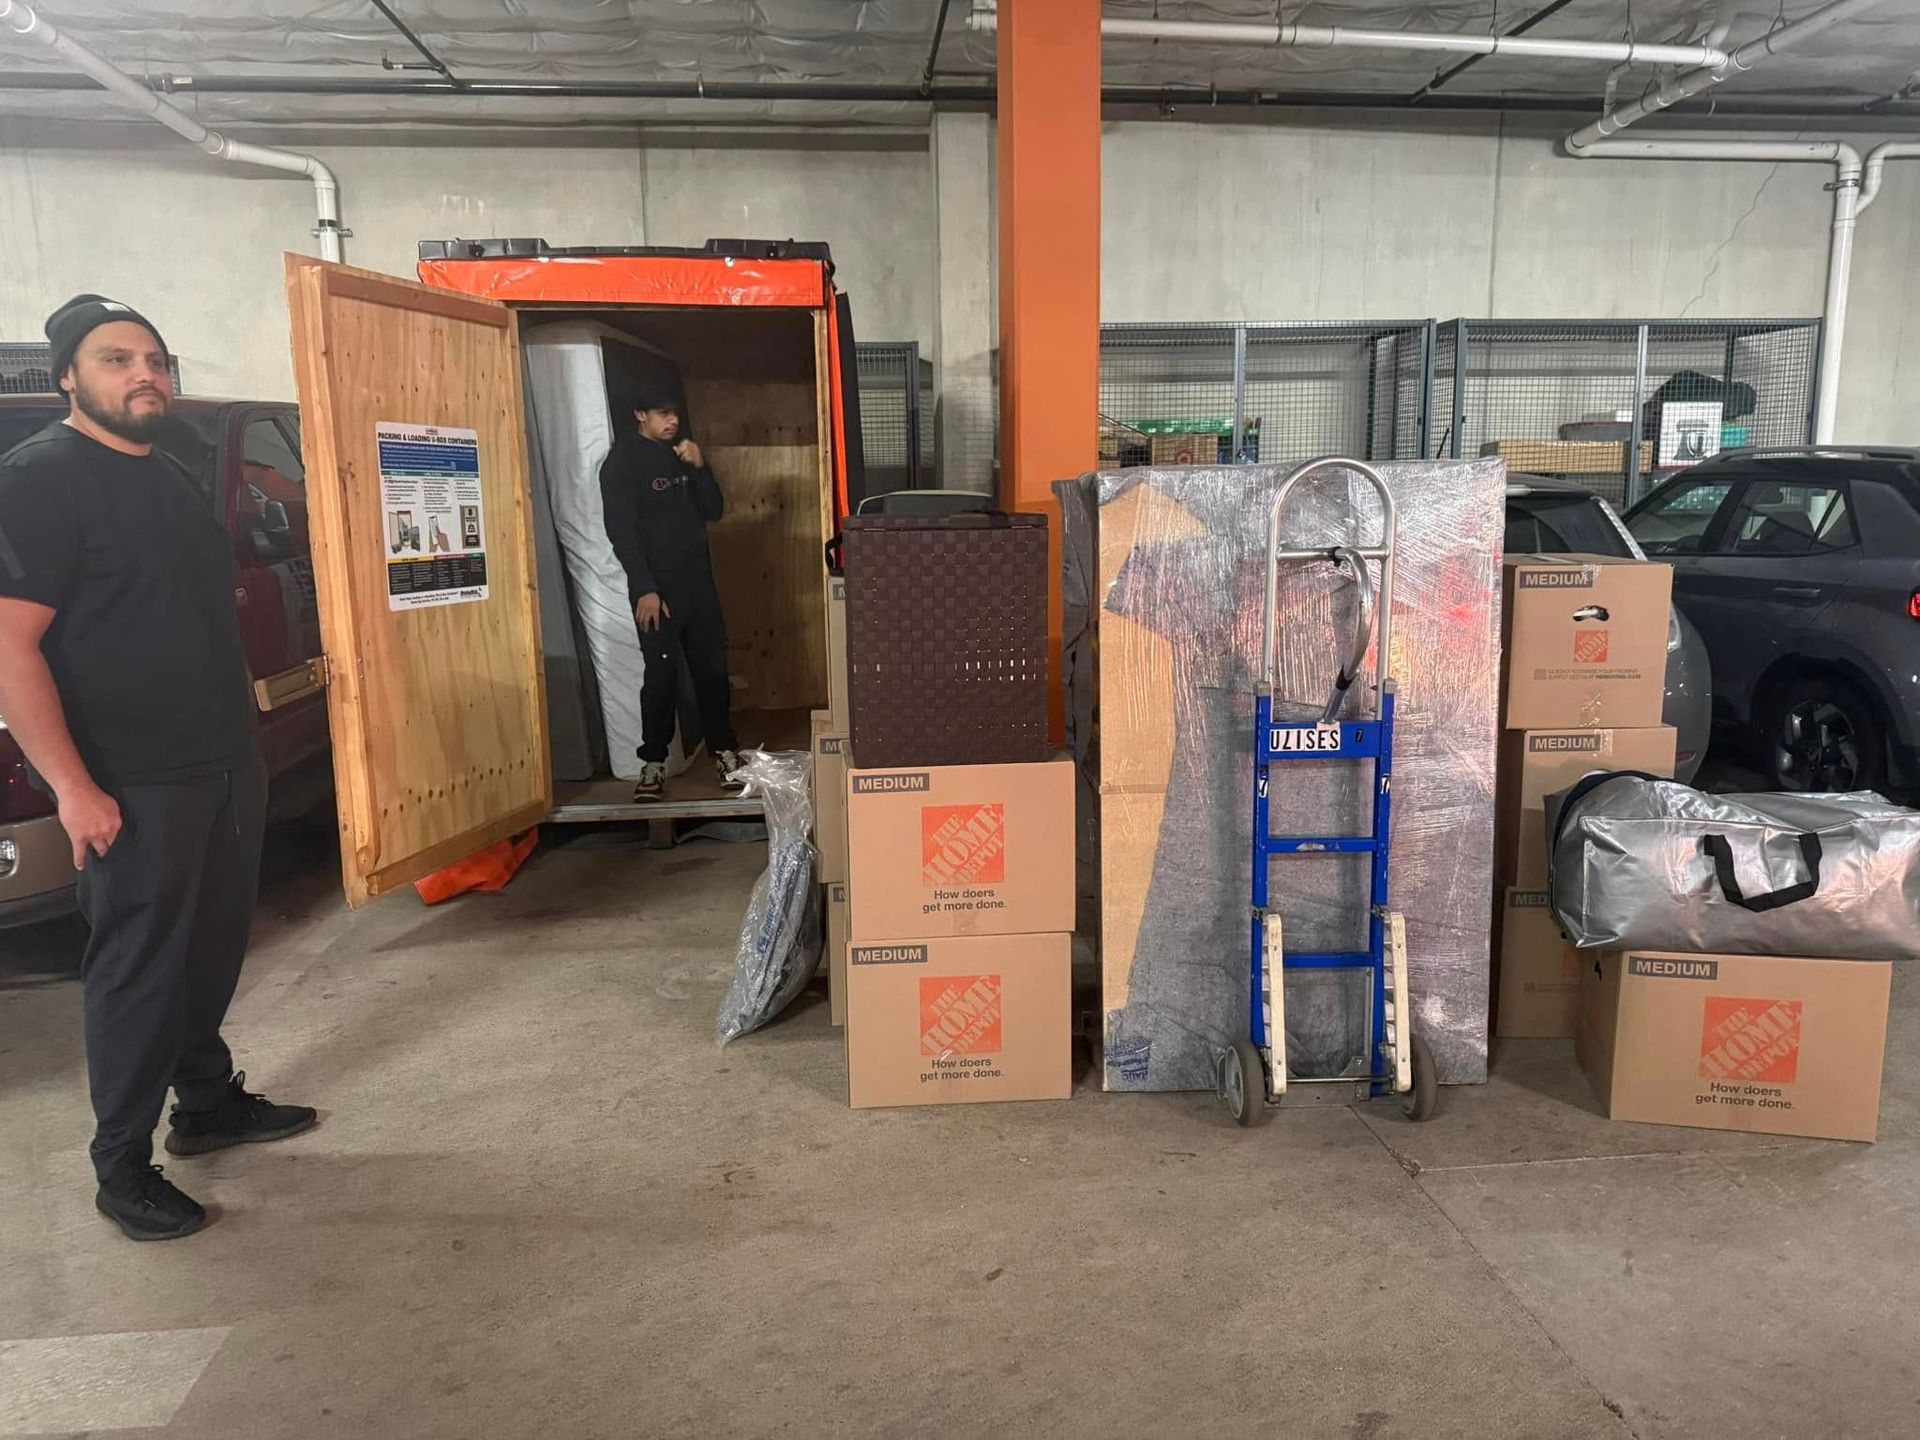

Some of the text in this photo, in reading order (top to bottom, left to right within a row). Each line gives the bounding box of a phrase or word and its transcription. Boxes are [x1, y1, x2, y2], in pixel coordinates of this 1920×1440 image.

[377, 432, 401, 440] PACKING
[407, 434, 430, 442] LOADING
[447, 437, 477, 446] CONTAINERS
[1525, 573, 1587, 586] MEDIUM
[1534, 737, 1596, 750] MEDIUM
[858, 776, 924, 791] MEDIUM
[924, 804, 1004, 884] HOME
[934, 888, 995, 900] How doers
[922, 899, 1007, 914] get more done.
[857, 948, 922, 962] MEDIUM
[1635, 960, 1711, 977] MEDIUM
[921, 975, 1001, 1055] HOME
[1700, 1000, 1801, 1077] HOME
[932, 1057, 992, 1069] How doers
[920, 1069, 1004, 1083] get more done.
[1710, 1082, 1782, 1097] How doers
[1695, 1094, 1717, 1105] get
[1720, 1097, 1756, 1107] more
